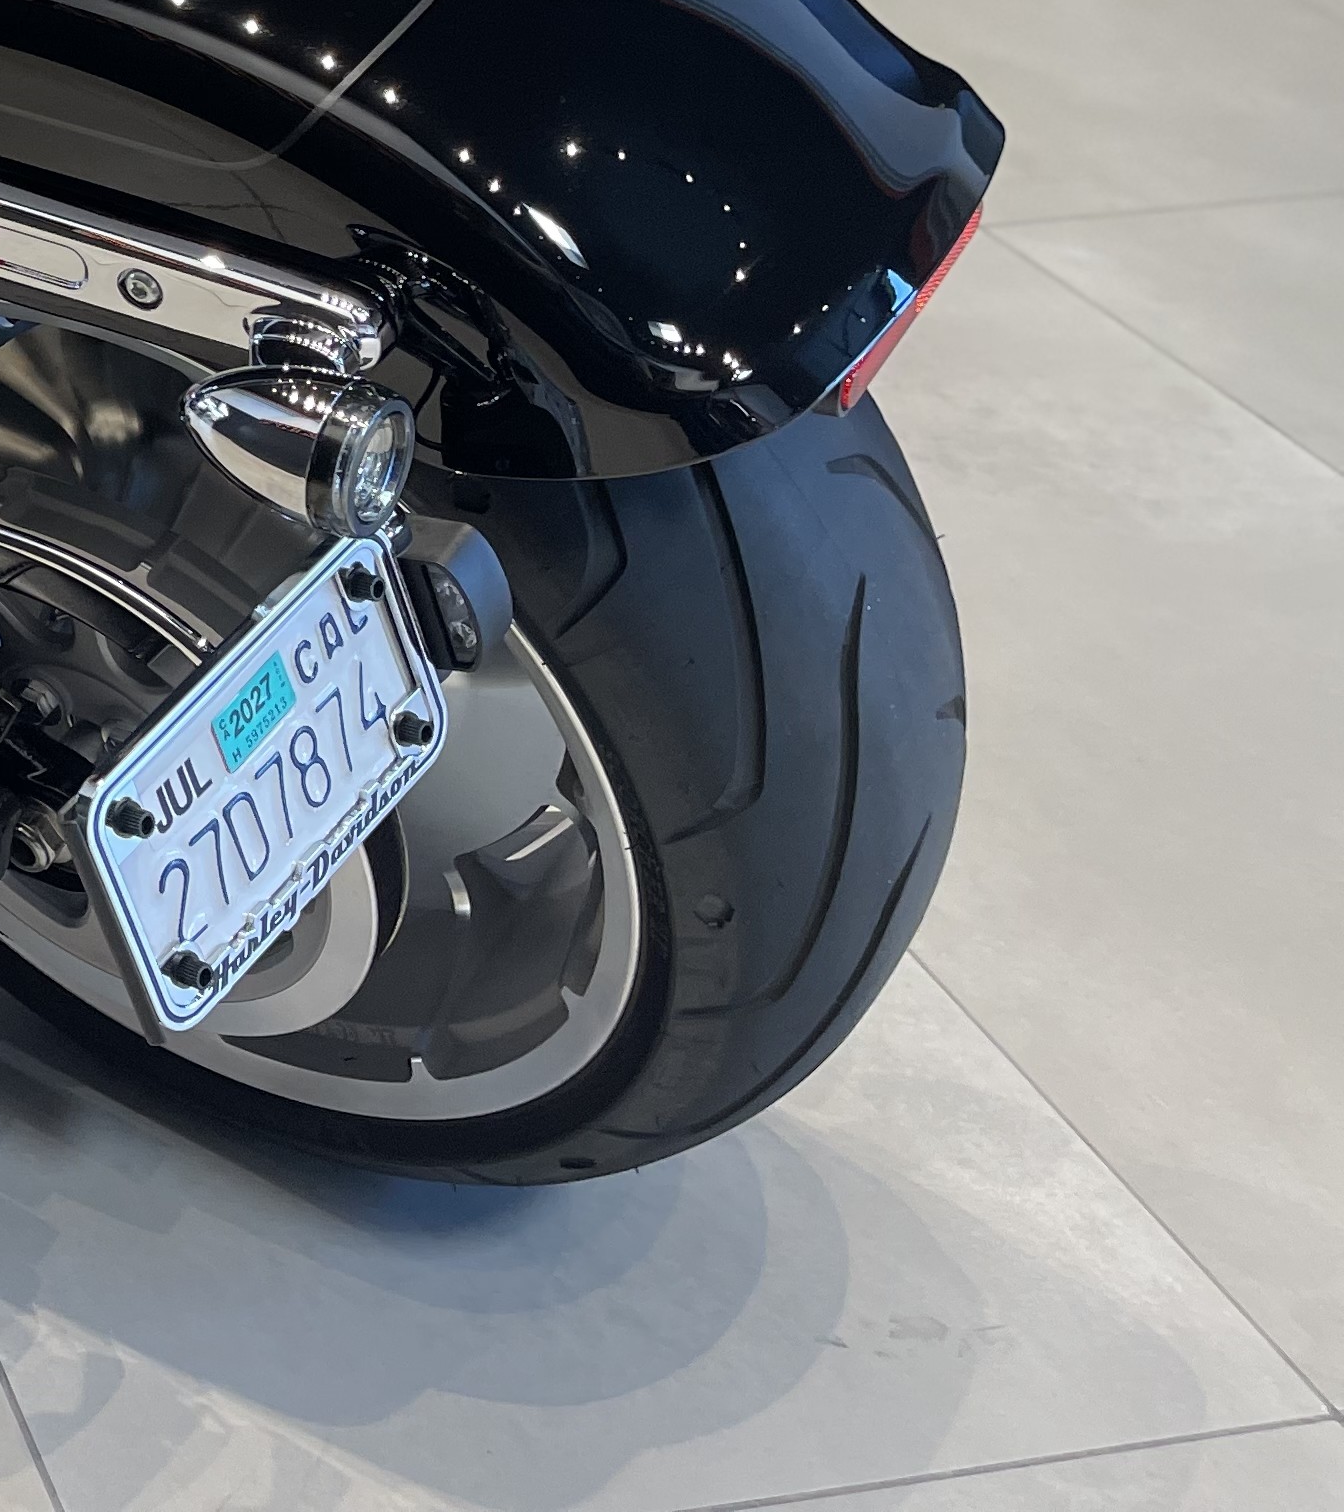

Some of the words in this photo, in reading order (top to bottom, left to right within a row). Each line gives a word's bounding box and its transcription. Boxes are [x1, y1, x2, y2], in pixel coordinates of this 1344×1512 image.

[295, 597, 368, 684] CAL
[229, 672, 271, 738] 2027
[156, 757, 213, 834] JUL
[231, 747, 242, 762] H
[159, 661, 390, 944] 27D7874
[211, 758, 420, 993] Harley-Davidson
